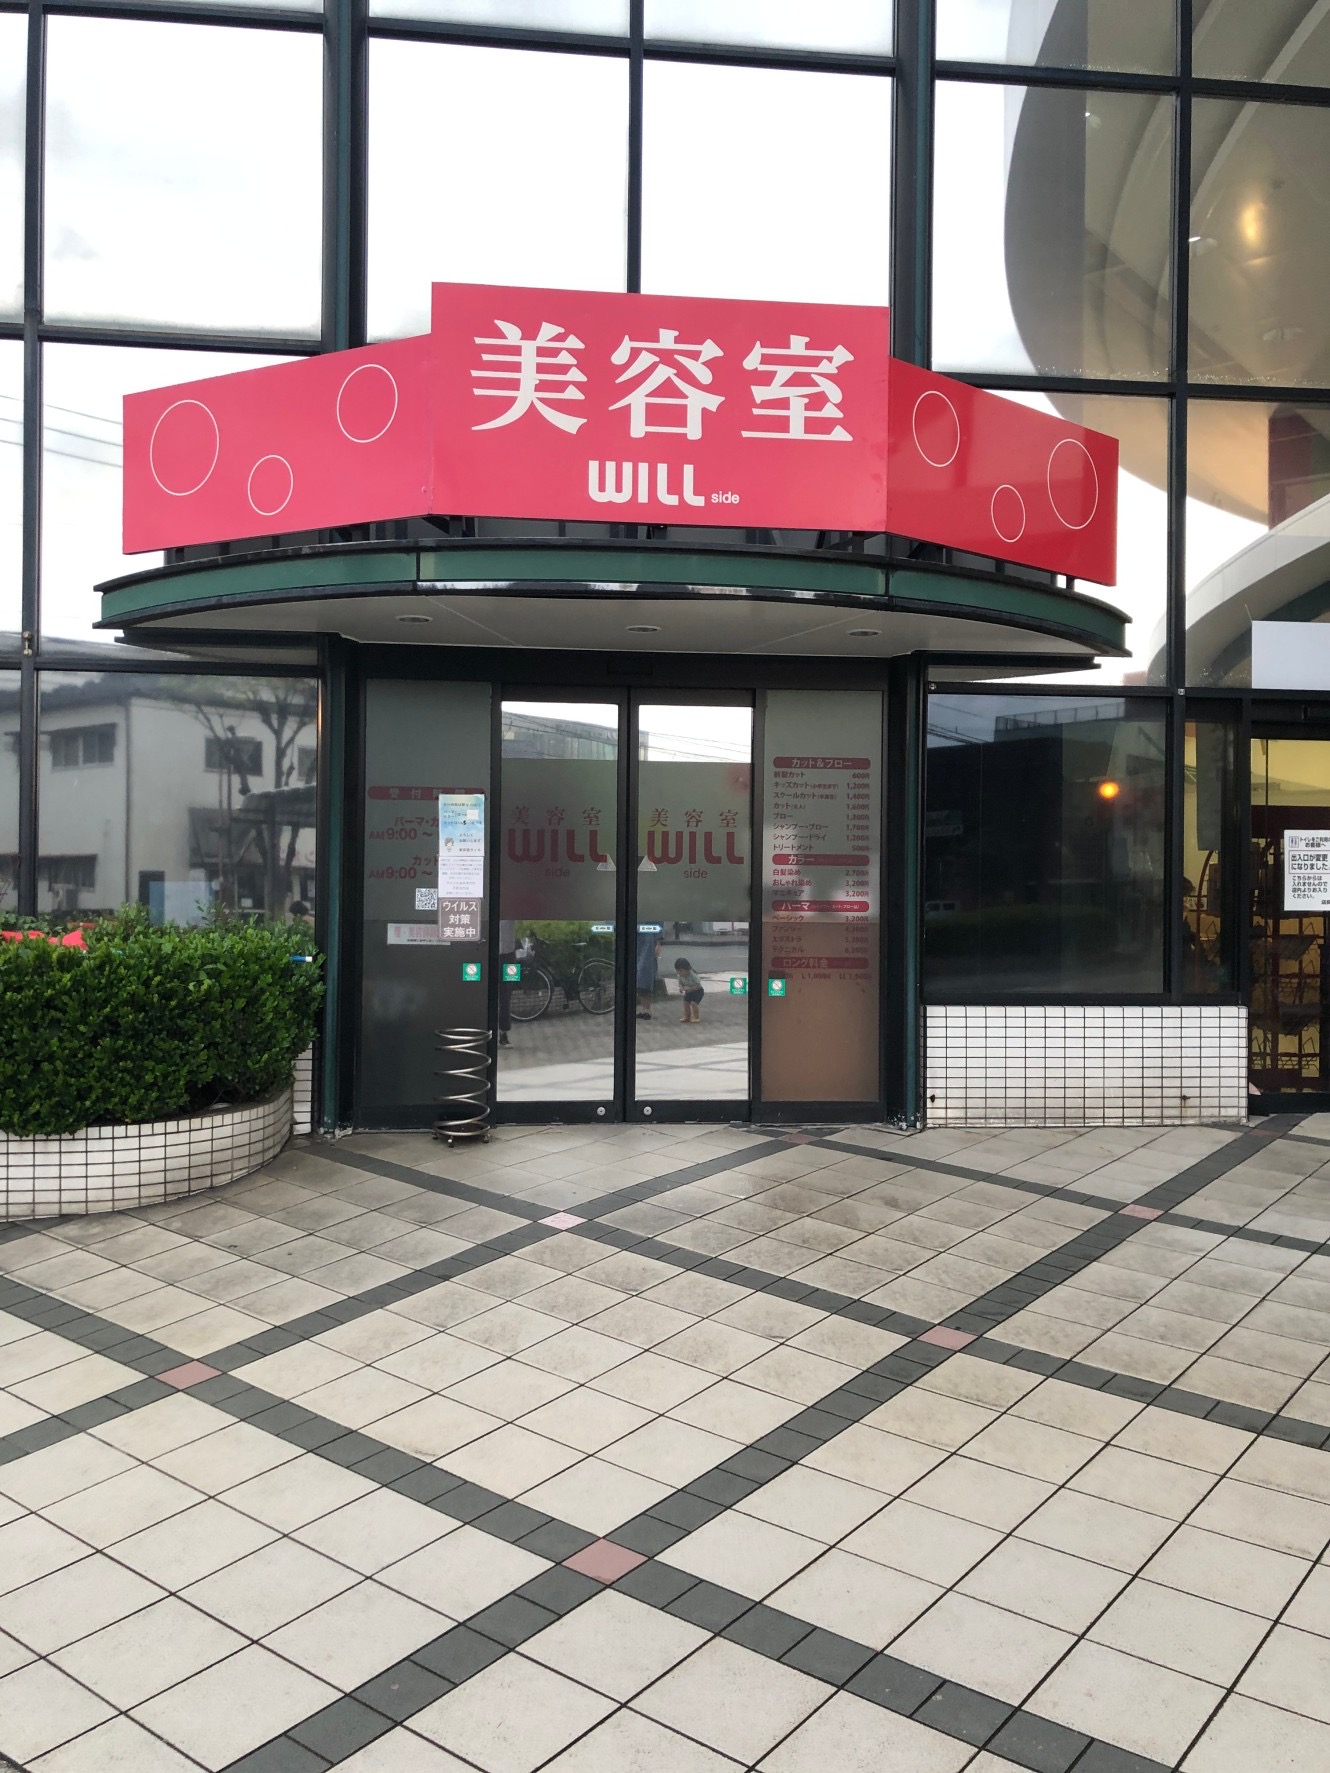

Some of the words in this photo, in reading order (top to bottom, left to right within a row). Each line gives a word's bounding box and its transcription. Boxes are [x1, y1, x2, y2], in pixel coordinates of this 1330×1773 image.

[470, 319, 854, 441] 美容室
[588, 460, 705, 506] WILL
[711, 491, 740, 504] side
[512, 806, 601, 826] 美容室
[650, 808, 739, 828] 美容室
[507, 828, 607, 863] WILL
[647, 830, 745, 865] WILL
[789, 855, 815, 865] カラー
[1291, 854, 1328, 862] 出入口が変更
[683, 867, 708, 879] side
[442, 901, 477, 912] ウイルス
[449, 914, 471, 925] 対策
[443, 927, 476, 938] 実施中
